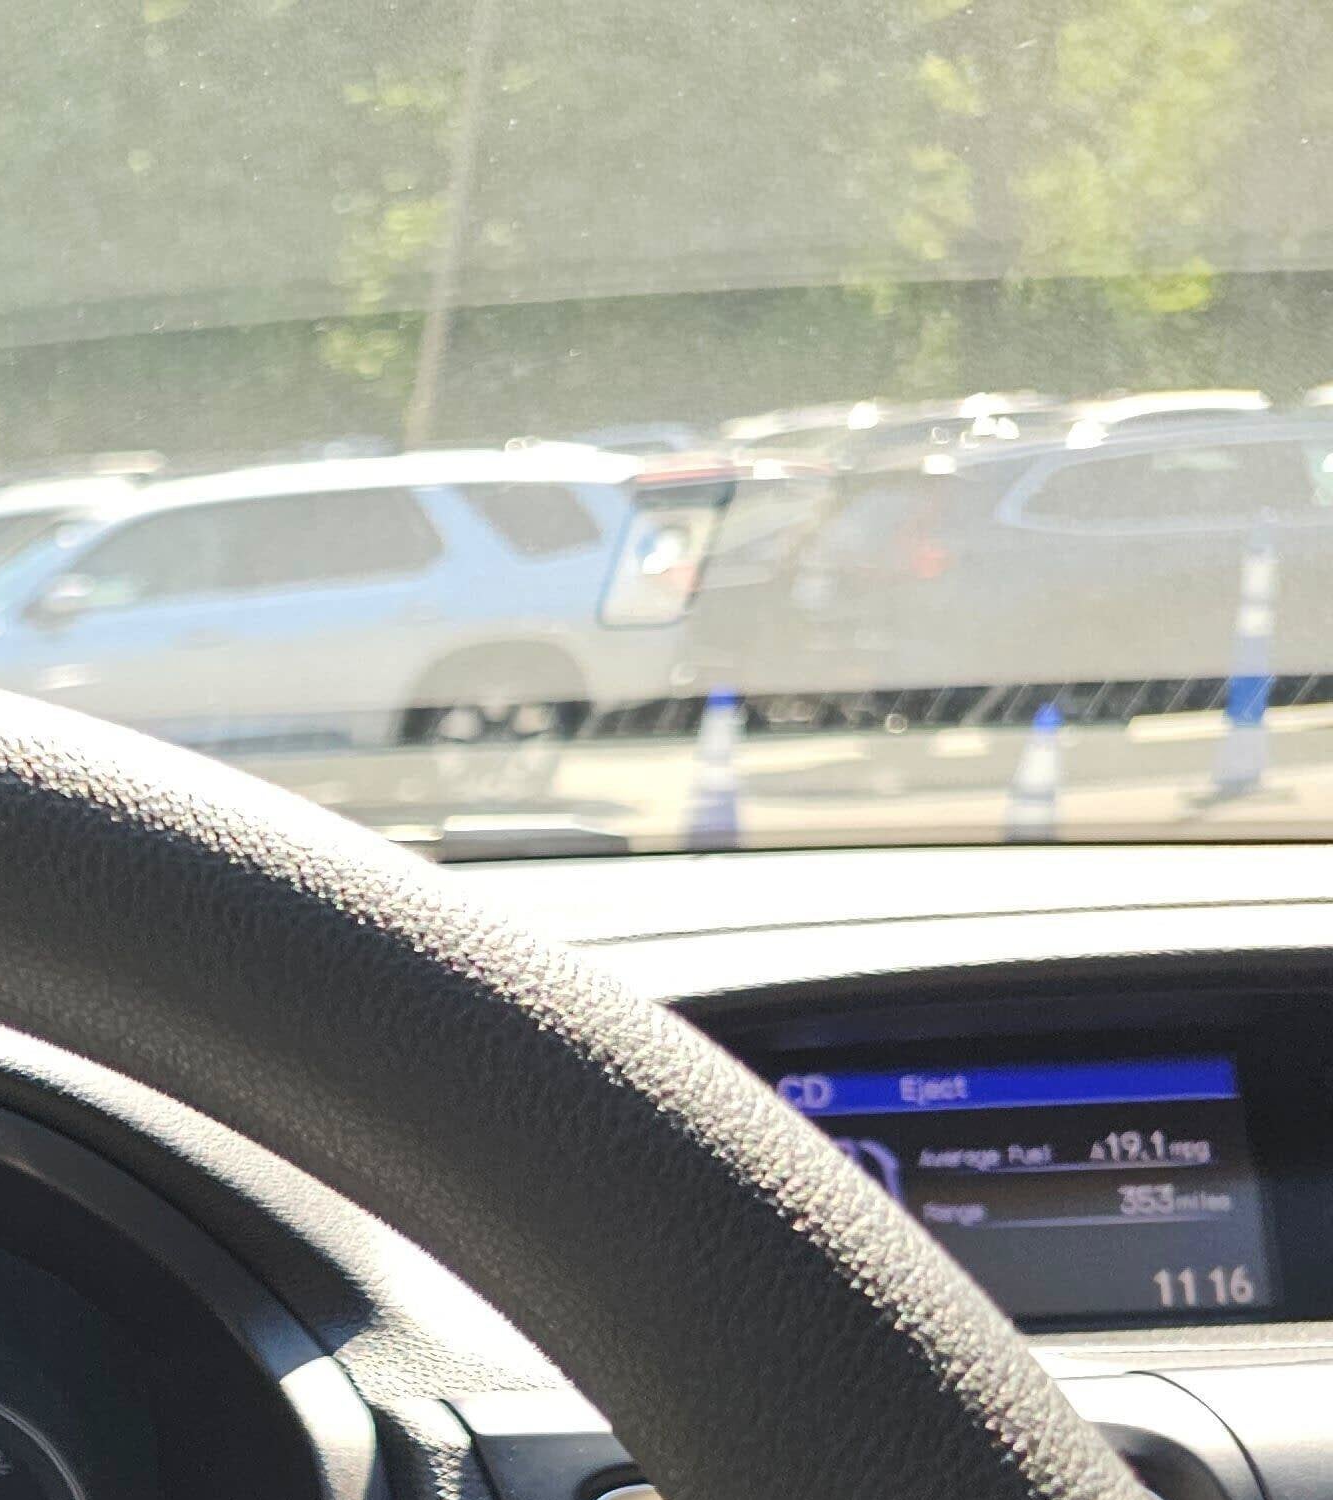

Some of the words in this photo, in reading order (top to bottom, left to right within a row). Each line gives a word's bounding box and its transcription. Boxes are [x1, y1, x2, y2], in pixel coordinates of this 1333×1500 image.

[777, 1074, 833, 1110] CD
[899, 1074, 970, 1106] Eject
[919, 1148, 1001, 1172] Average
